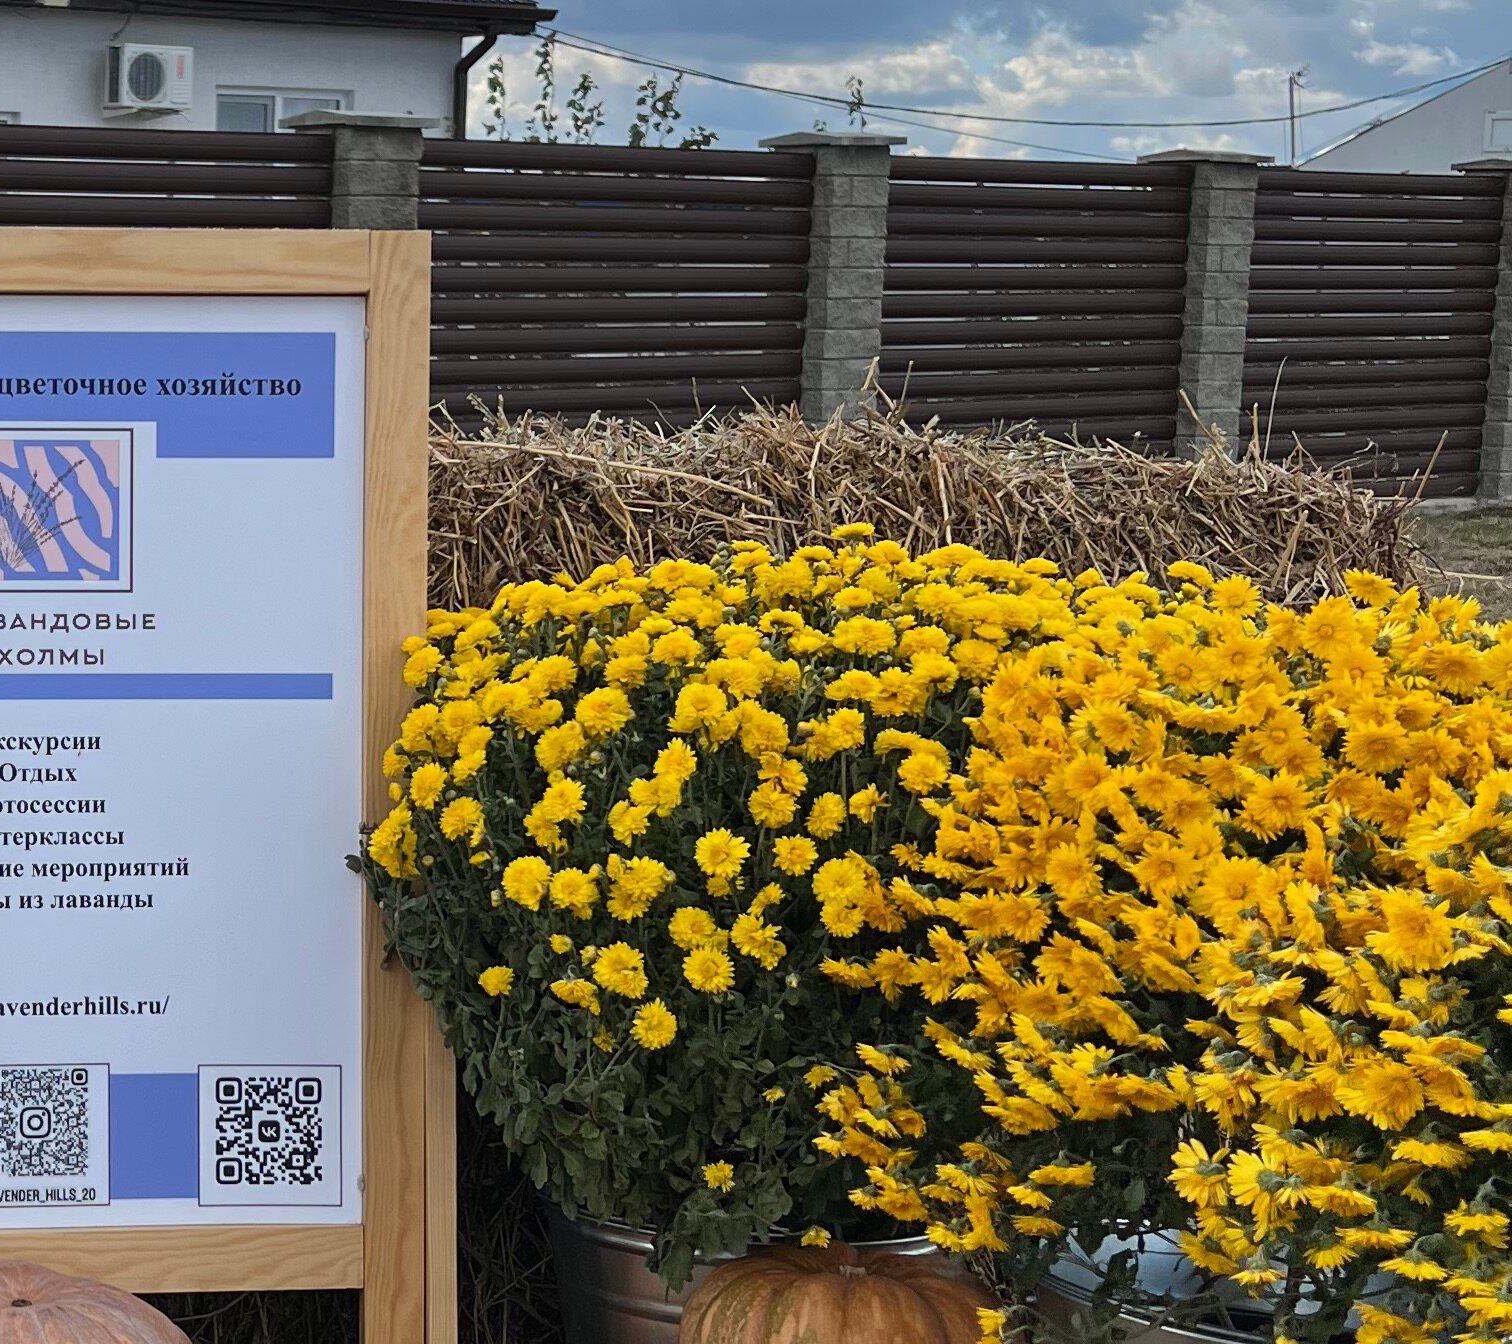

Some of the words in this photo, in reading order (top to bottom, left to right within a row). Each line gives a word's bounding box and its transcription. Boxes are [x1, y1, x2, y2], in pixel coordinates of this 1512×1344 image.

[156, 372, 303, 398] хозяйство
[30, 856, 190, 884] мероприятий
[18, 893, 44, 910] из
[50, 892, 155, 912] лаванды
